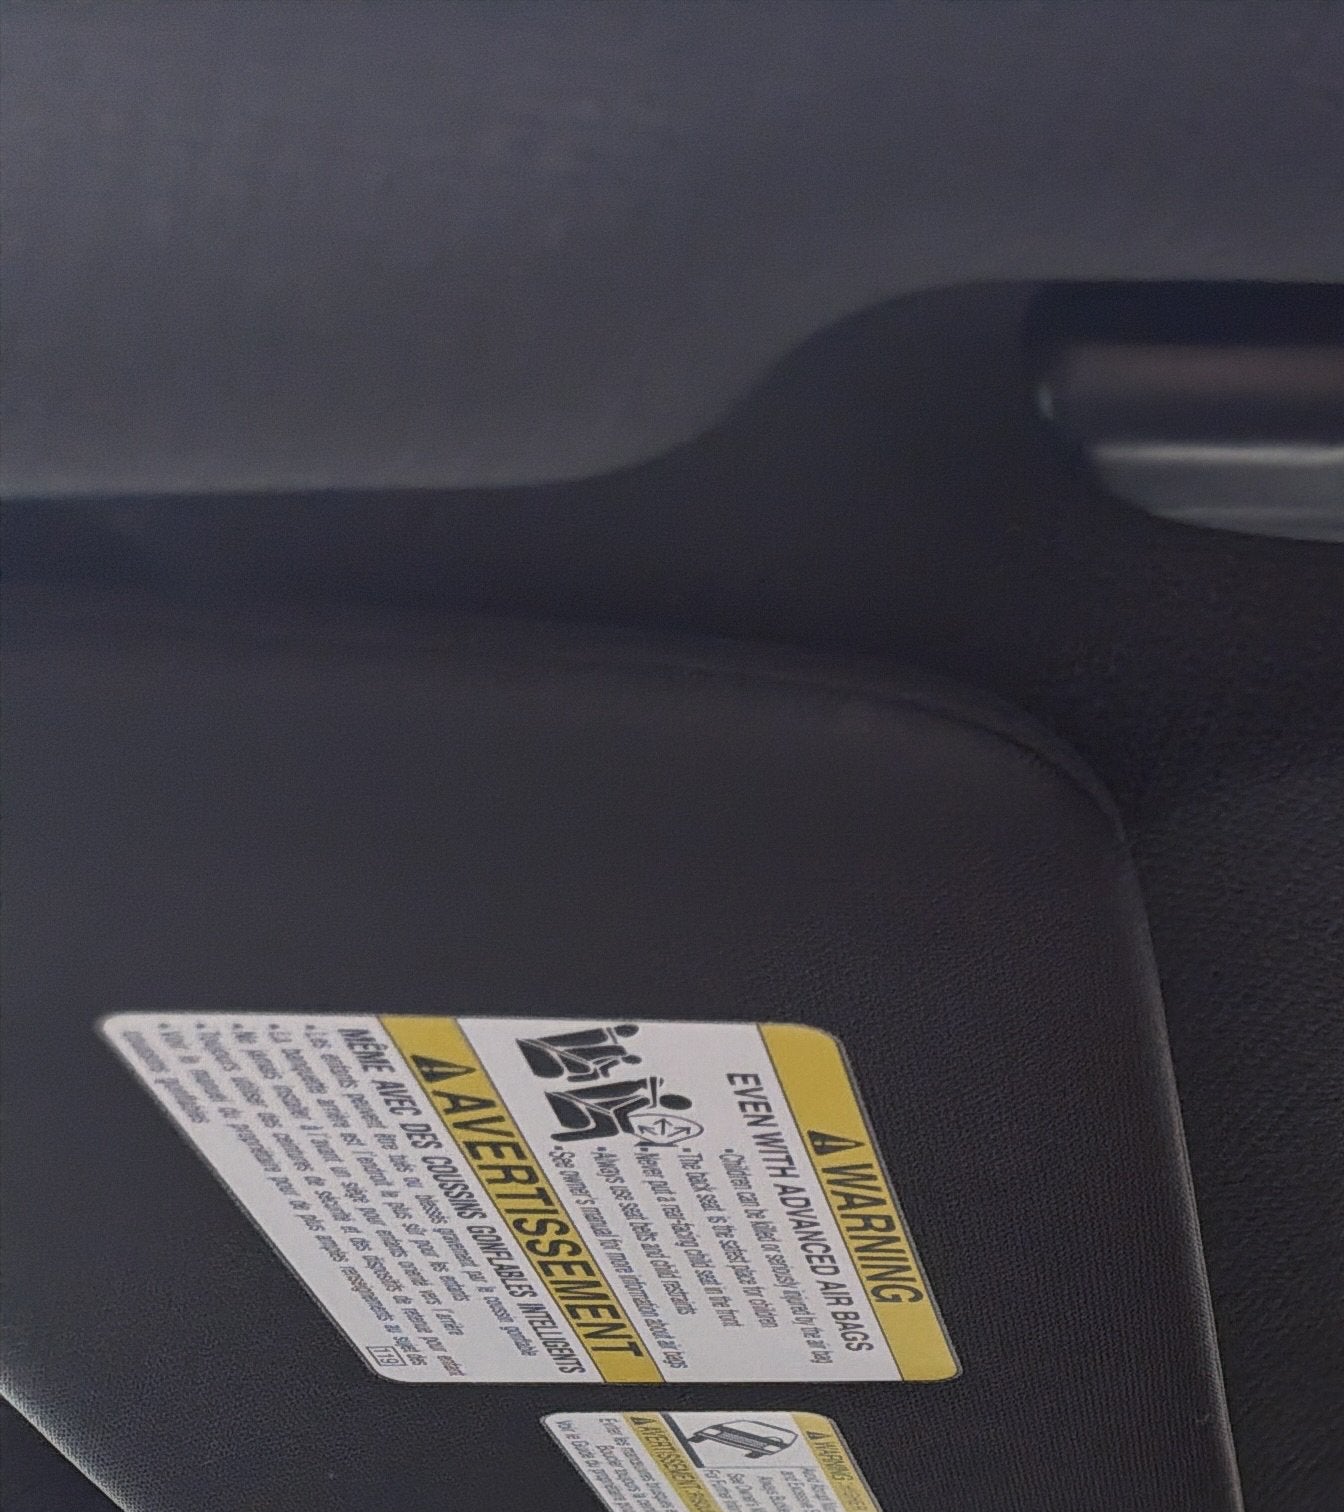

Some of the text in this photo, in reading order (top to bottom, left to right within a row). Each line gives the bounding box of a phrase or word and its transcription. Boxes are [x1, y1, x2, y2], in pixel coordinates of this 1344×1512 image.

[634, 1152, 664, 1178] Never
[677, 1152, 704, 1169] The
[718, 1154, 752, 1189] Children
[641, 1180, 677, 1195] put
[685, 1172, 717, 1192] back
[337, 1028, 586, 1374] MÊME AVEC DES COUSSINS GONFLABLES INTELLIGENTS
[696, 1194, 726, 1211] seat
[736, 1191, 760, 1207] can
[726, 1073, 874, 1352] EVEN WITH ADVANCED AIR BAGS
[744, 1208, 769, 1219] be
[431, 1089, 644, 1357] AVERTISSEMENT
[660, 1204, 701, 1247] rear-facing
[711, 1225, 737, 1238] the
[590, 1151, 698, 1315] Always use seat belts and child restraints
[821, 1163, 924, 1303] WARNING
[718, 1240, 751, 1263] safest
[760, 1244, 781, 1253] or
[548, 1151, 688, 1368] See owner's manual for more information about air bags
[683, 1249, 716, 1268] child
[694, 1269, 723, 1285] seat
[725, 1264, 758, 1285] place
[765, 1254, 801, 1288] seriously
[704, 1286, 726, 1294] in
[742, 1286, 766, 1297] for
[708, 1295, 733, 1307] the
[780, 1290, 816, 1315] injured
[715, 1309, 745, 1327] front
[748, 1299, 779, 1328] children
[791, 1316, 818, 1326] by
[800, 1327, 824, 1338] the
[806, 1339, 831, 1349] air
[810, 1350, 834, 1363] bag
